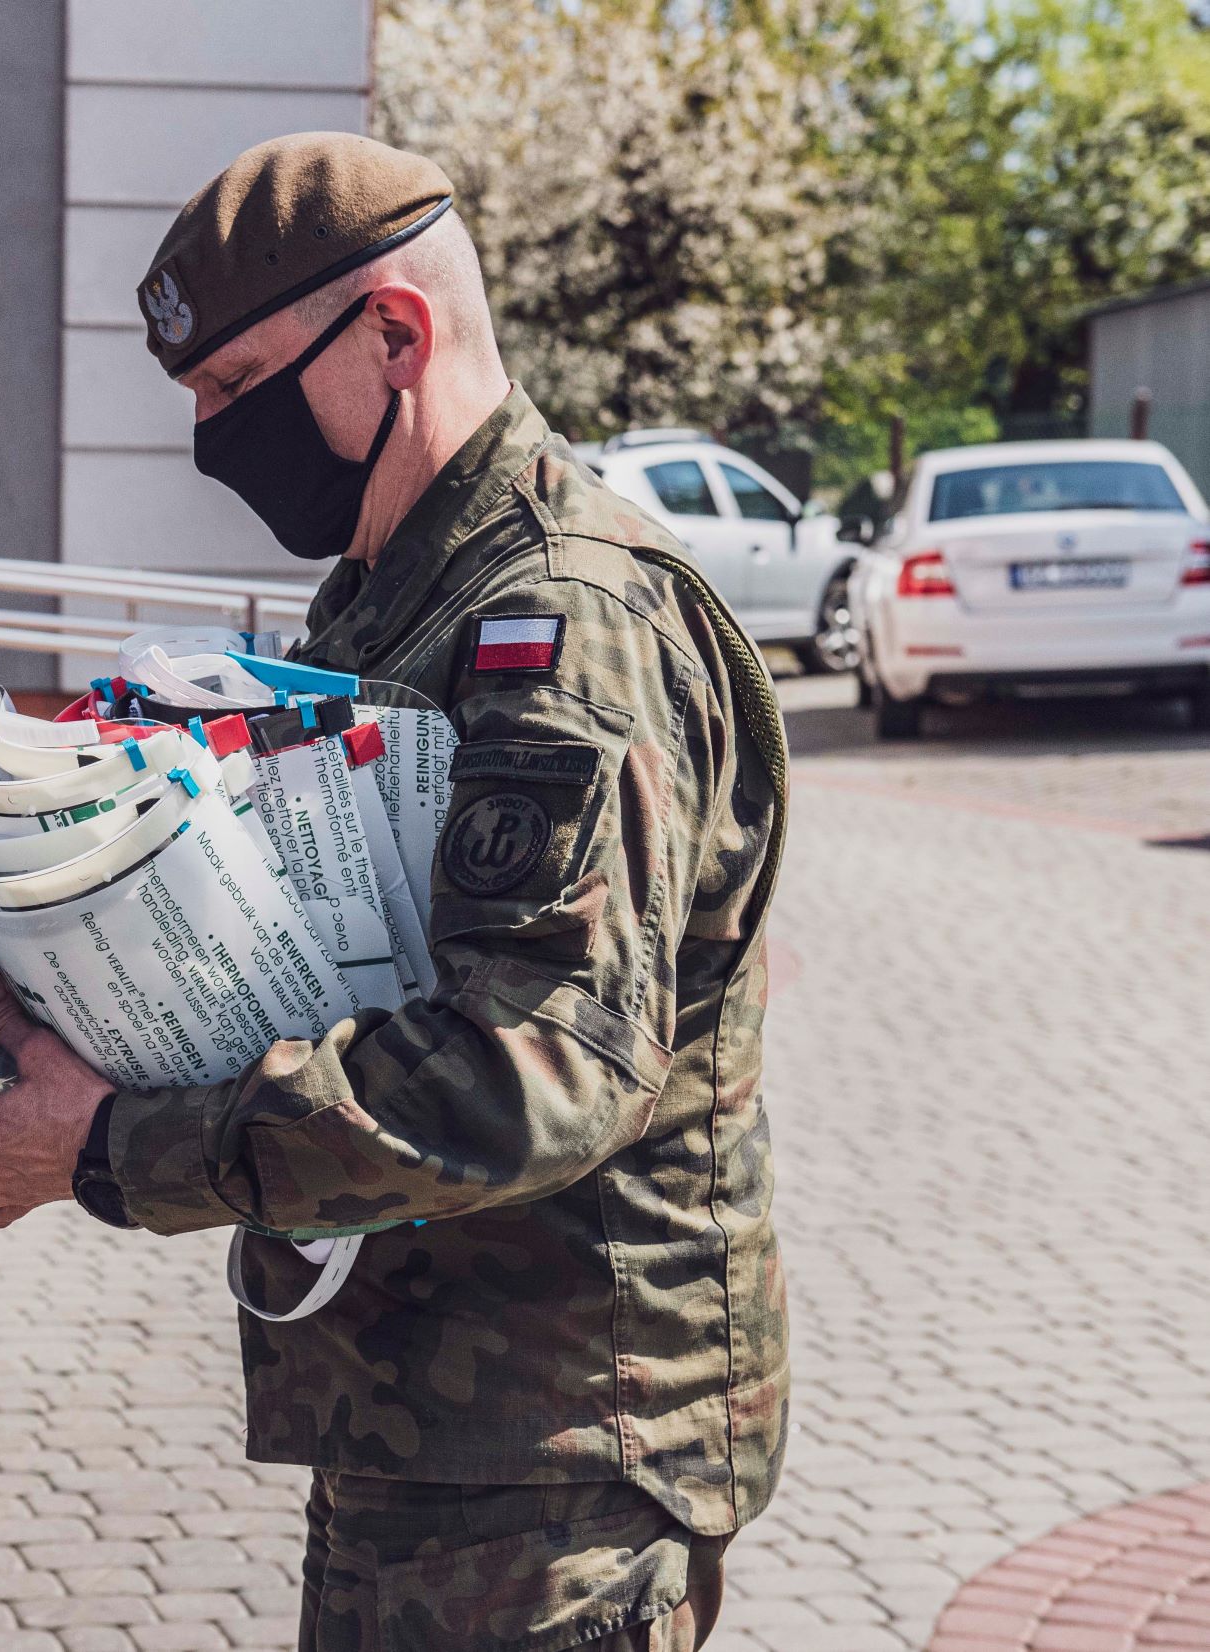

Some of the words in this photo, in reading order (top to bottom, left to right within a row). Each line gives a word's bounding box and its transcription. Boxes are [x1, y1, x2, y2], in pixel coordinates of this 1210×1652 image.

[433, 724, 444, 749] mit
[254, 781, 275, 825] tiède
[313, 756, 351, 862] thermoformé
[325, 740, 352, 808] détaillés
[431, 753, 446, 804] erfolgt
[272, 787, 299, 853] nettoyer
[290, 858, 304, 874] la
[343, 811, 358, 833] sur
[349, 837, 363, 853] le
[141, 860, 210, 966] Thermoformeren
[207, 965, 236, 1004] wordt
[196, 830, 224, 874] Maak
[219, 873, 255, 922] gebruik
[252, 919, 271, 948] van
[268, 947, 283, 966] de
[79, 911, 110, 951] Reinig
[134, 995, 159, 1023] met
[152, 1026, 173, 1051] een
[136, 882, 189, 966] handleiding.
[215, 1009, 235, 1036] kan
[151, 937, 186, 987] worden
[182, 986, 211, 1027] tussen
[250, 945, 272, 976] voor
[276, 929, 325, 999] BEWERKEN
[42, 951, 59, 968] De
[56, 971, 117, 1055] extrusierichting
[114, 1058, 132, 1080] van
[53, 985, 106, 1060] aangegeven
[107, 981, 122, 997] en
[118, 999, 148, 1031] spoel
[139, 1033, 157, 1049] na
[151, 1051, 175, 1074] met
[160, 1010, 206, 1069] REINIGEN
[106, 1028, 149, 1080] EXTRUSIE
